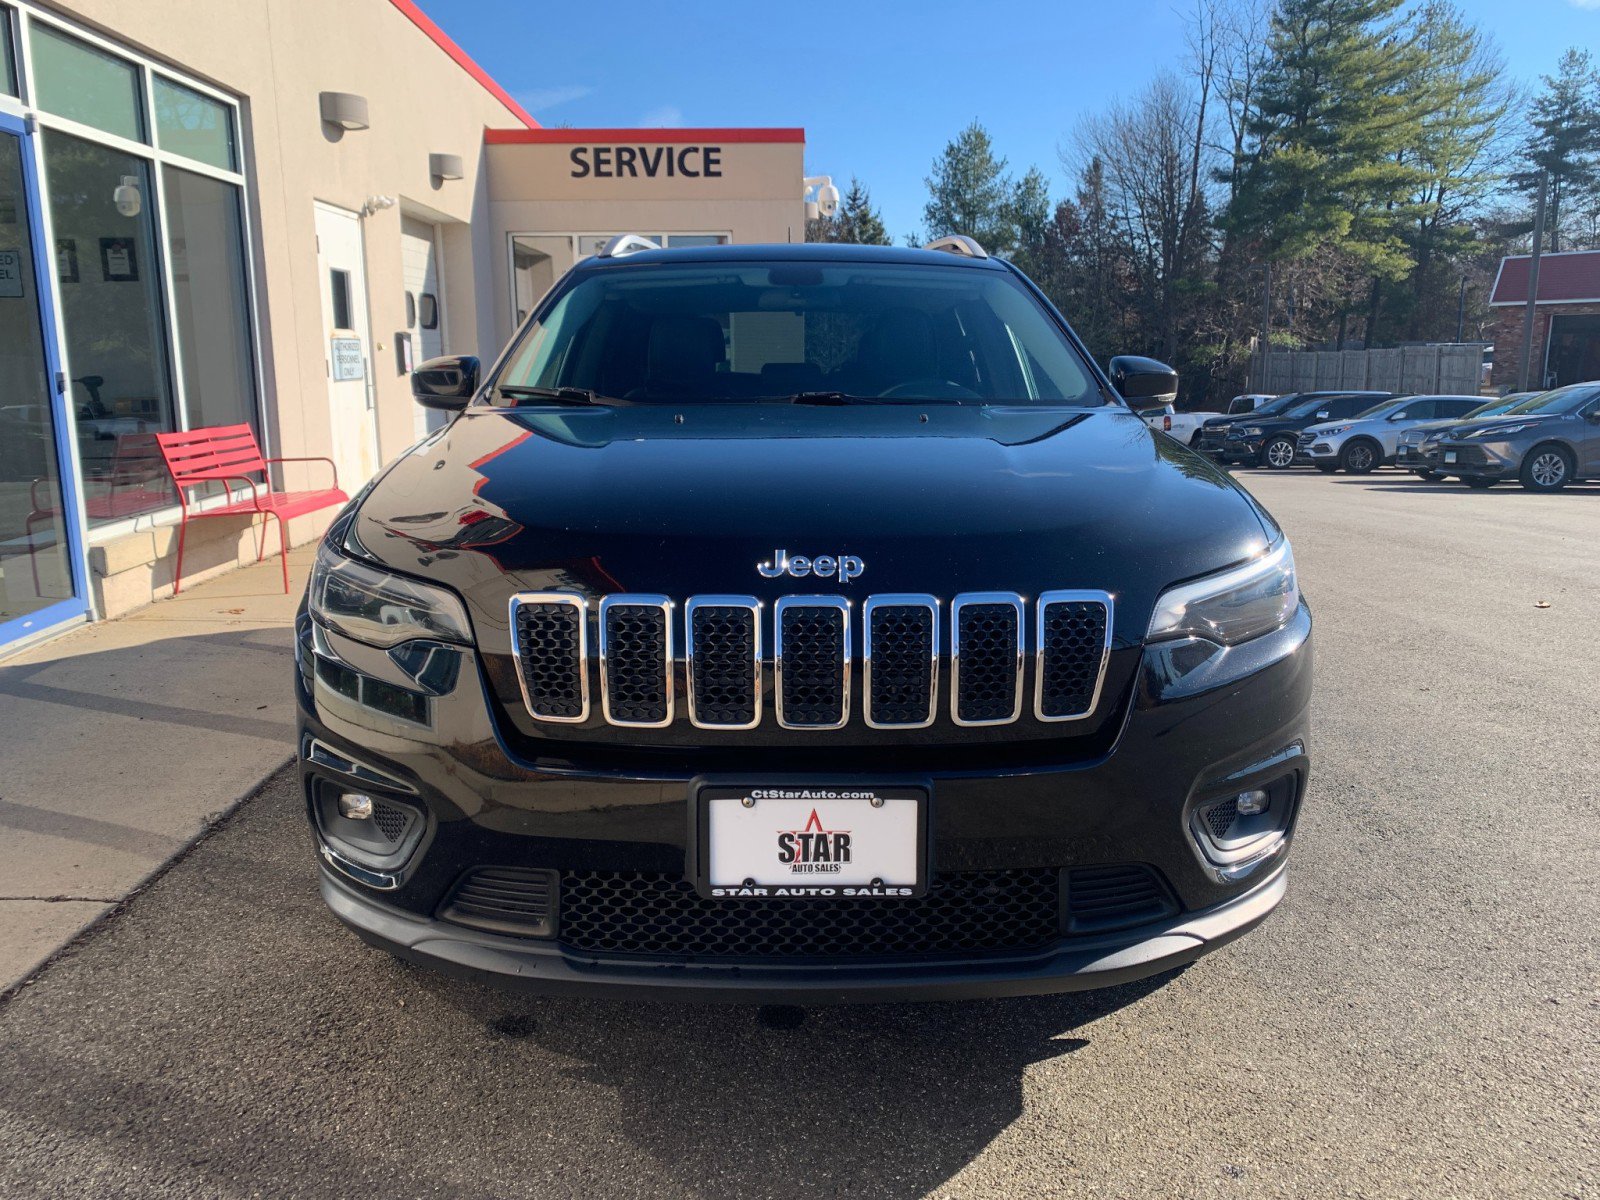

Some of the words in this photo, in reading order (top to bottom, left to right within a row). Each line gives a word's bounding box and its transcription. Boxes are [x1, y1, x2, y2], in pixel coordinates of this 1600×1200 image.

[570, 146, 722, 178] SERVICE
[757, 549, 865, 583] Jeep
[751, 789, 875, 799] CtStarAuto.com
[777, 832, 852, 864] STAR
[792, 863, 813, 873] AUTO
[814, 863, 840, 873] SALES
[711, 888, 769, 897] STAR
[774, 888, 836, 897] AUTO
[842, 888, 913, 897] SALES
